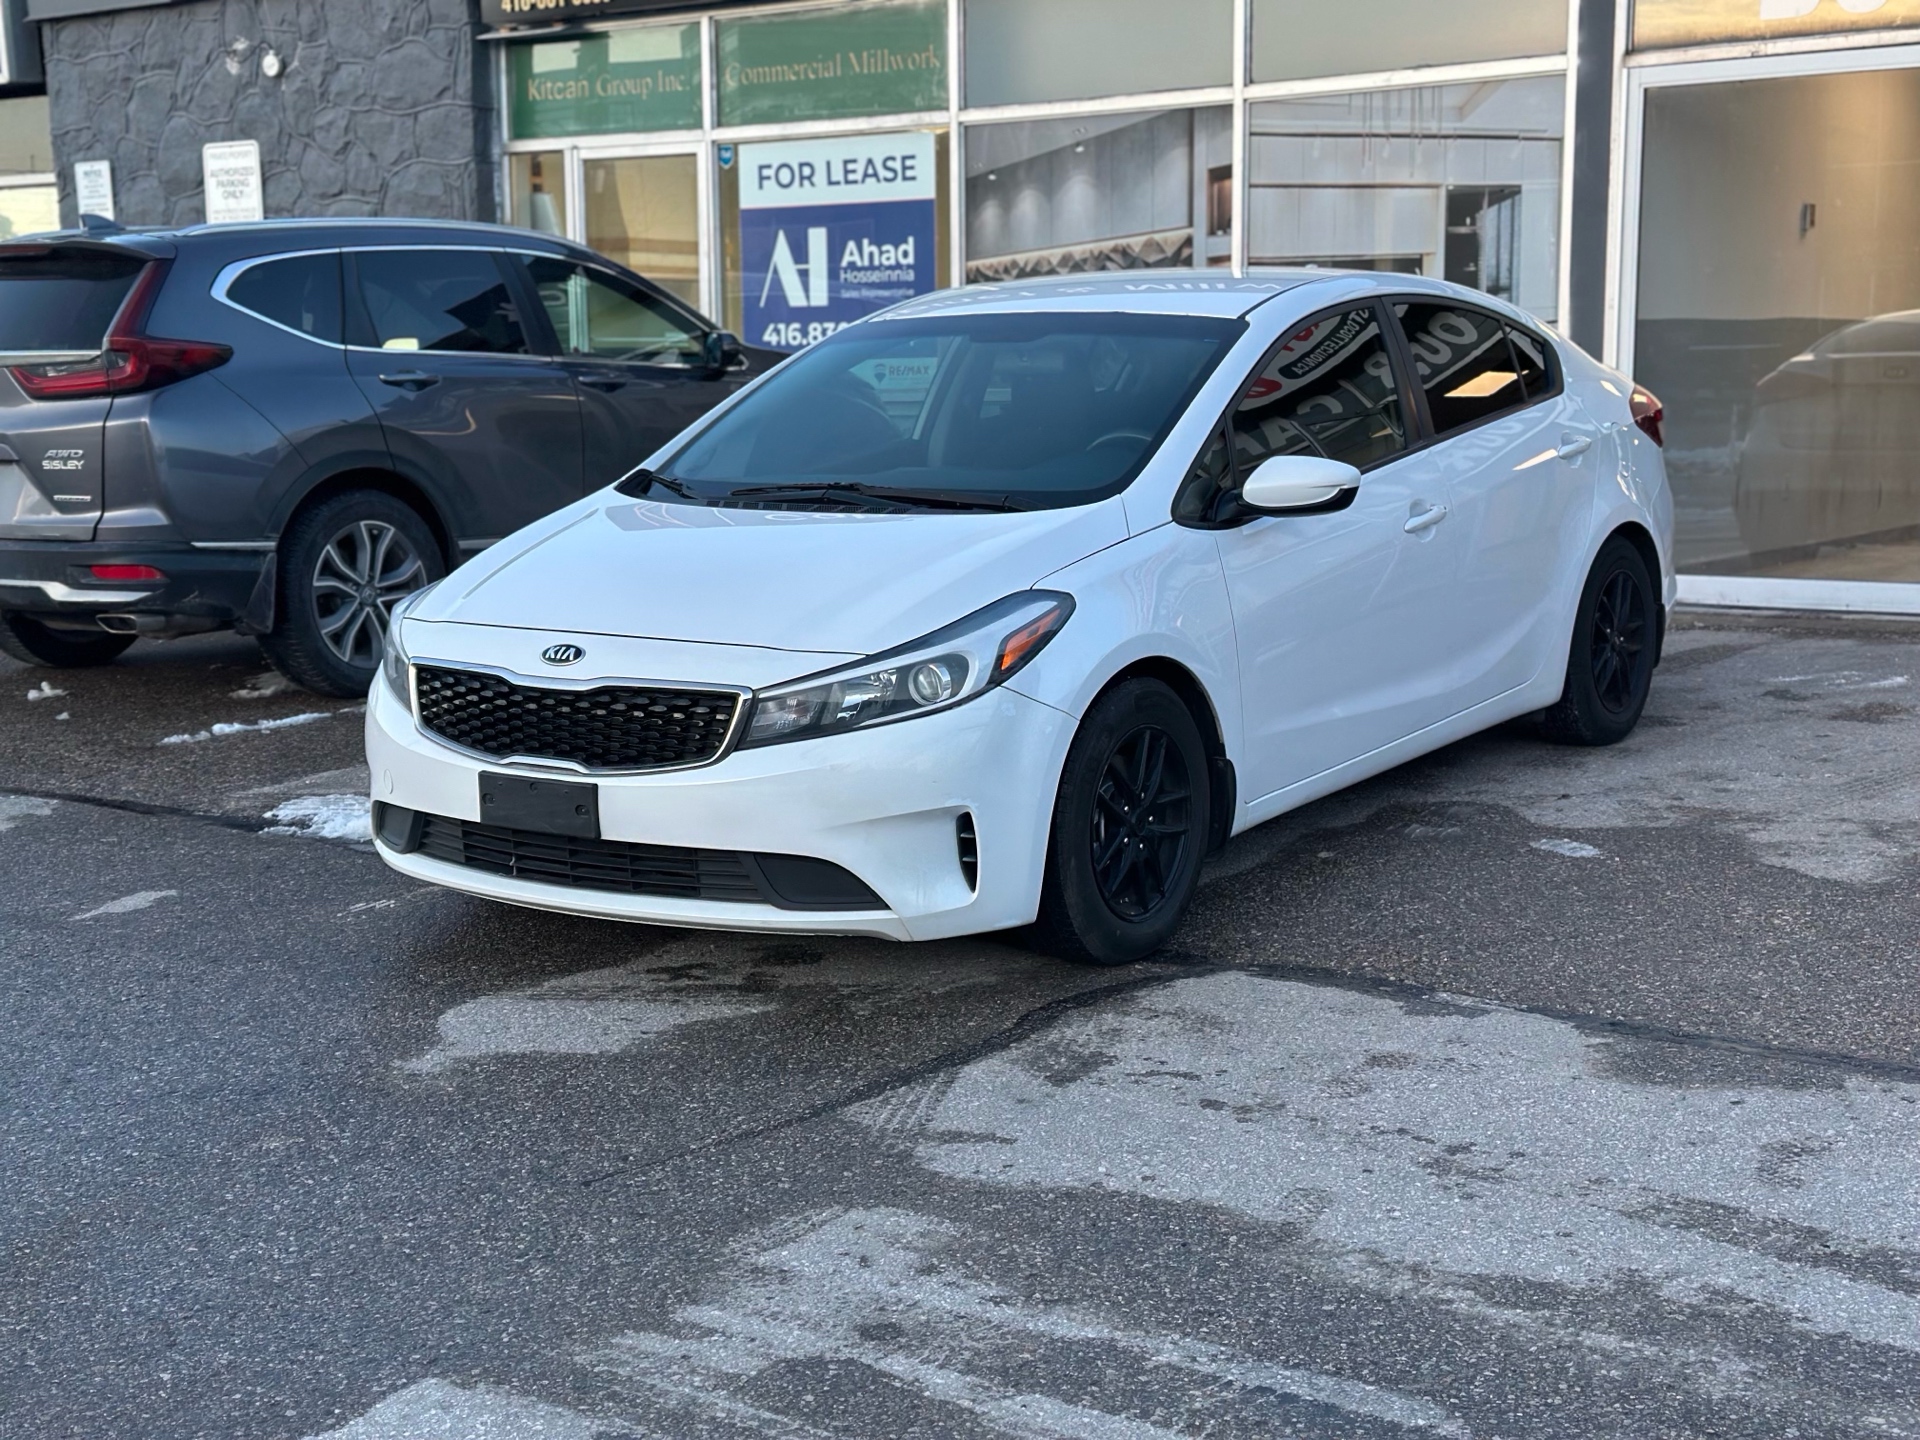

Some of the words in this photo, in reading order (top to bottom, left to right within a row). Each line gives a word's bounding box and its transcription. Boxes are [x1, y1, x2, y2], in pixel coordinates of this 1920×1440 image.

[724, 53, 842, 87] Commercial
[849, 44, 941, 75] Millwork
[528, 77, 589, 101] Kitcan
[596, 73, 653, 100] Group
[657, 70, 691, 92] Inc.
[758, 162, 815, 190] FOR
[826, 155, 917, 186] LEASE
[216, 178, 250, 189] PARKING
[222, 189, 245, 200] ONLY
[840, 235, 915, 267] Ahad
[840, 267, 915, 284] Hosseinnia
[888, 365, 929, 377] RE/MAX
[45, 449, 84, 458] AWD
[42, 460, 84, 470] SISLEY
[545, 646, 576, 661] KIA
